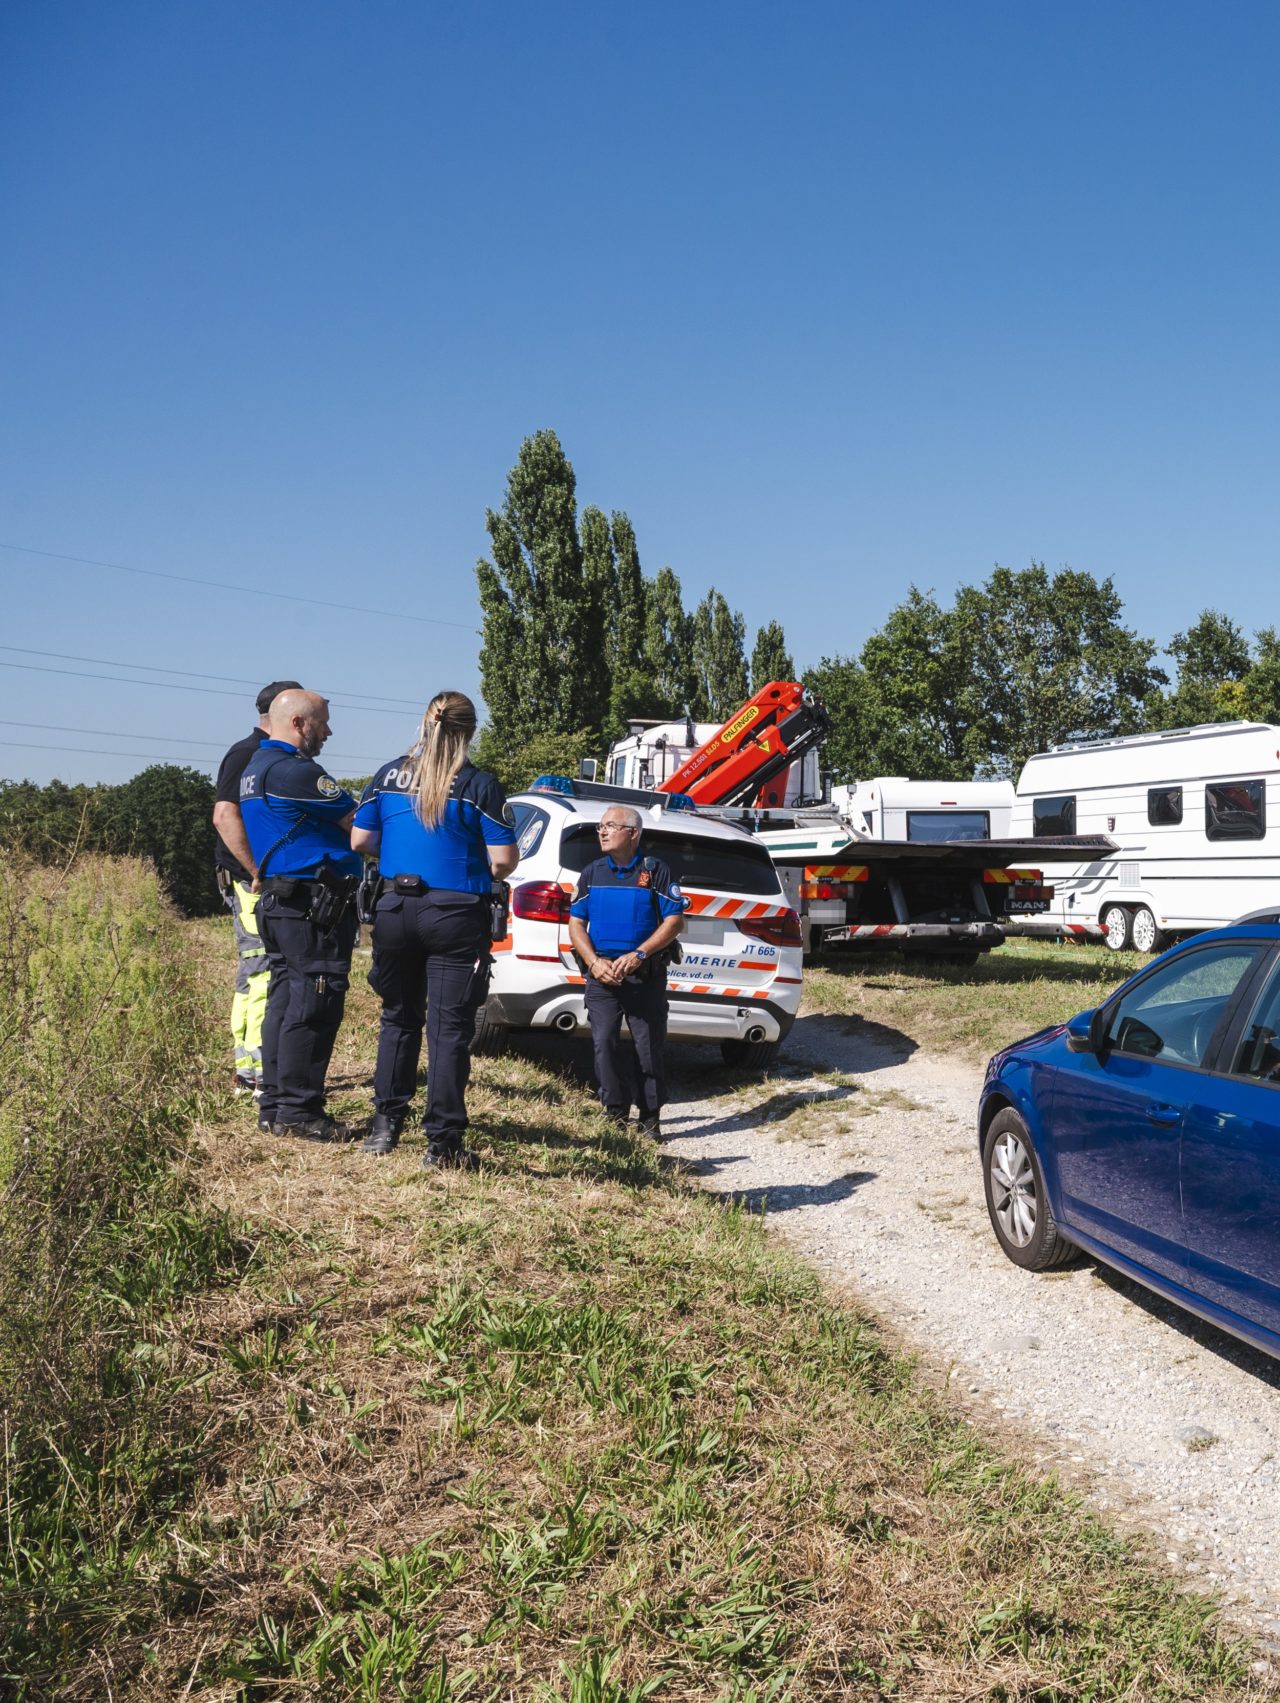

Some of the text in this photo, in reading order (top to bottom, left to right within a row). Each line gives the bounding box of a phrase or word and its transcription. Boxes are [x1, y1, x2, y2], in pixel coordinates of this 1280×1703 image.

[723, 707, 758, 741] PALFINGER
[682, 768, 692, 778] PK
[1011, 901, 1045, 909] MAN
[742, 944, 776, 957] JT 665
[685, 955, 737, 968] MERIE
